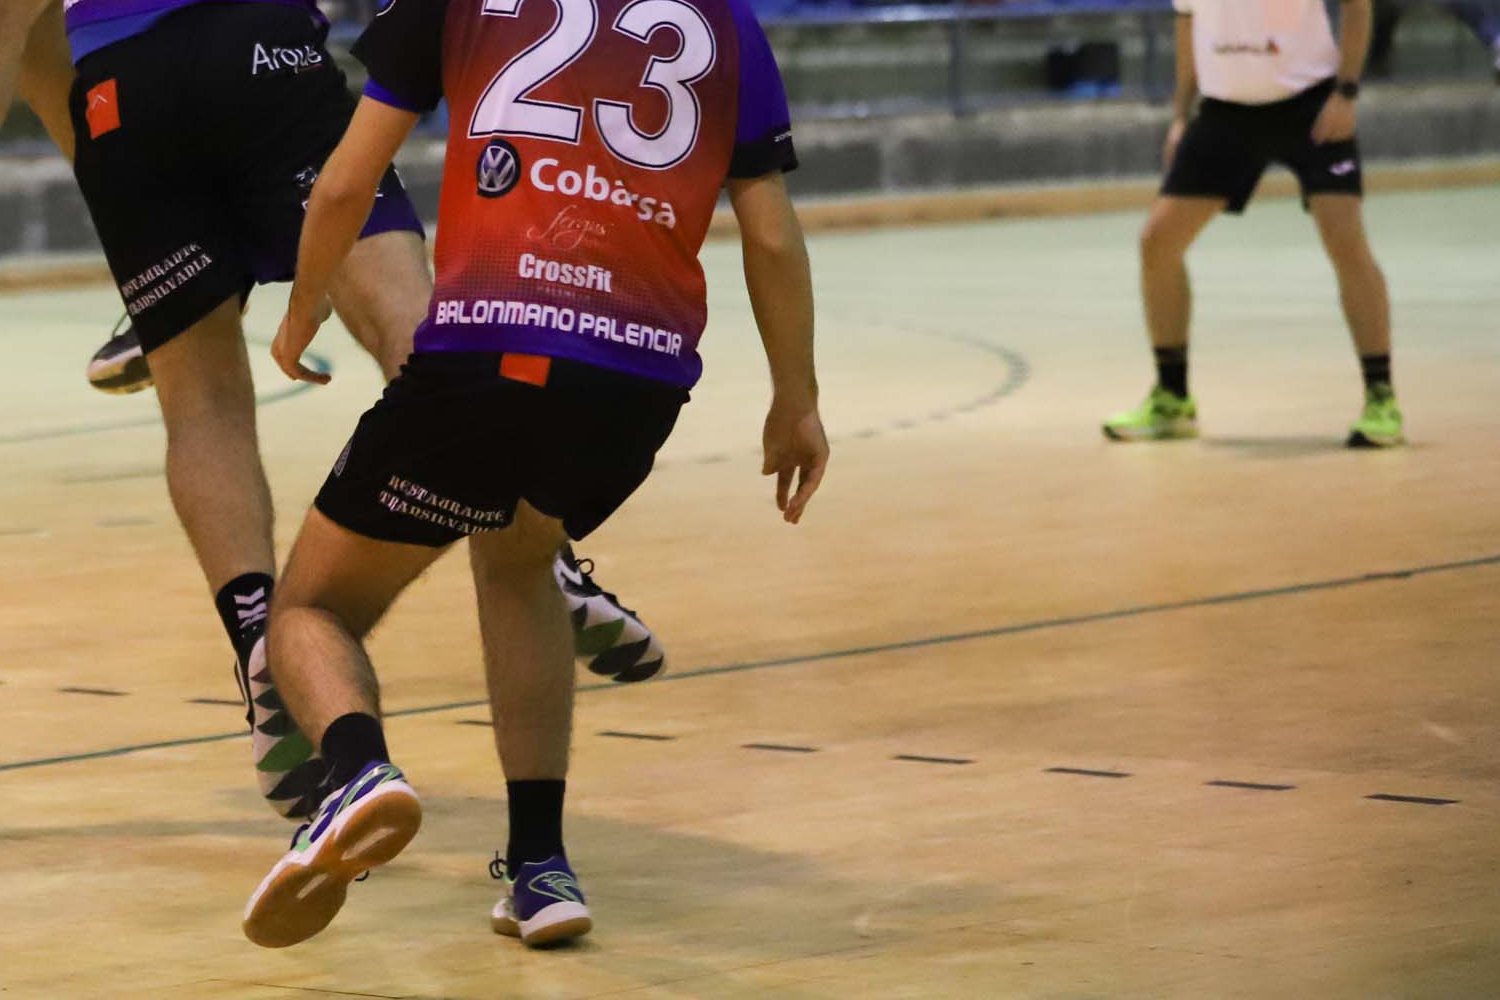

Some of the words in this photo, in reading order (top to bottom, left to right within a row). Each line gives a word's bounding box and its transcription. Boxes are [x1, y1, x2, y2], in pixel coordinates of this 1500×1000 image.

[252, 43, 322, 74] Arque
[518, 253, 612, 293] CrossFit
[435, 300, 574, 332] BALONMANO
[578, 312, 682, 357] PALENCIA
